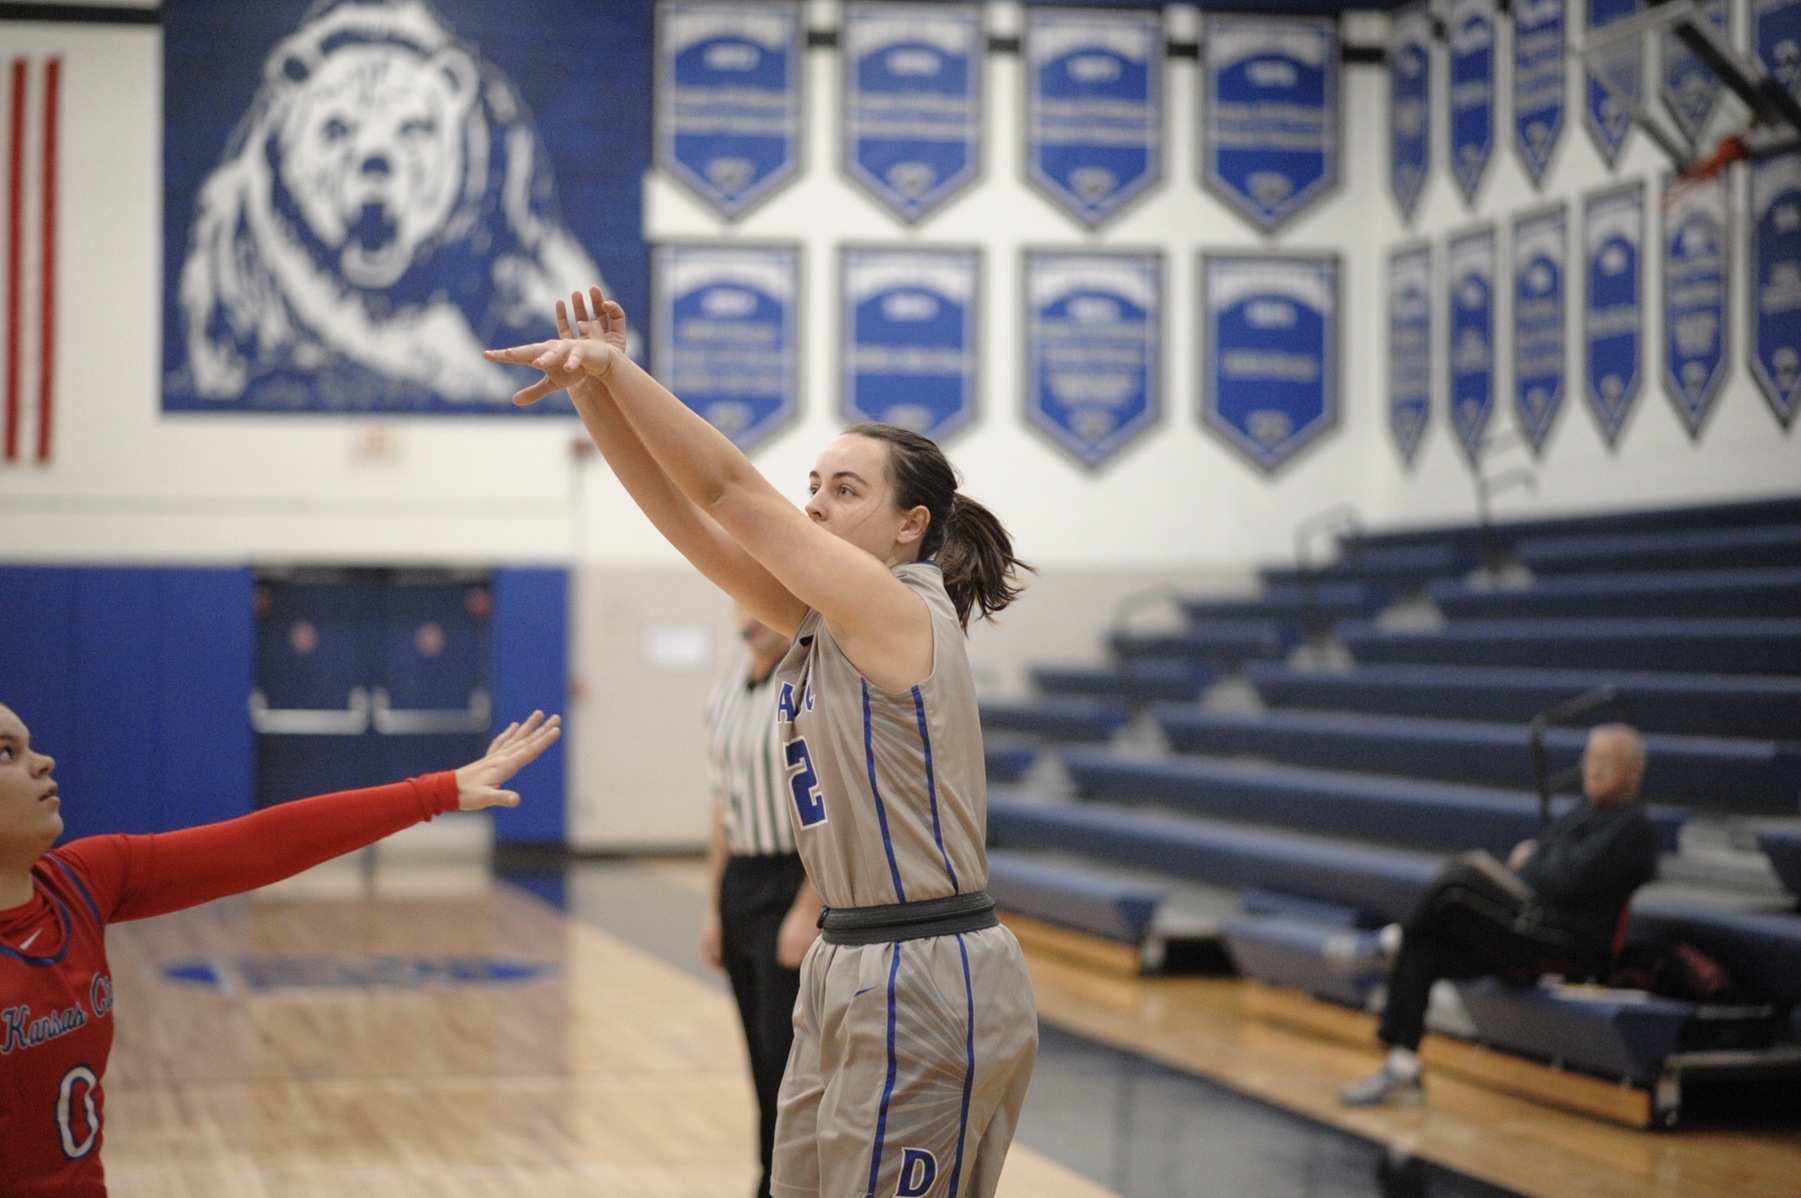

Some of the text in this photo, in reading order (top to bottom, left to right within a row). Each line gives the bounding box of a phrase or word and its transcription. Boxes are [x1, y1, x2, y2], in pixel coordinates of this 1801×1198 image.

[0, 1001, 88, 1054] Kansas
[57, 1062, 98, 1160] 0
[893, 1146, 938, 1198] D
